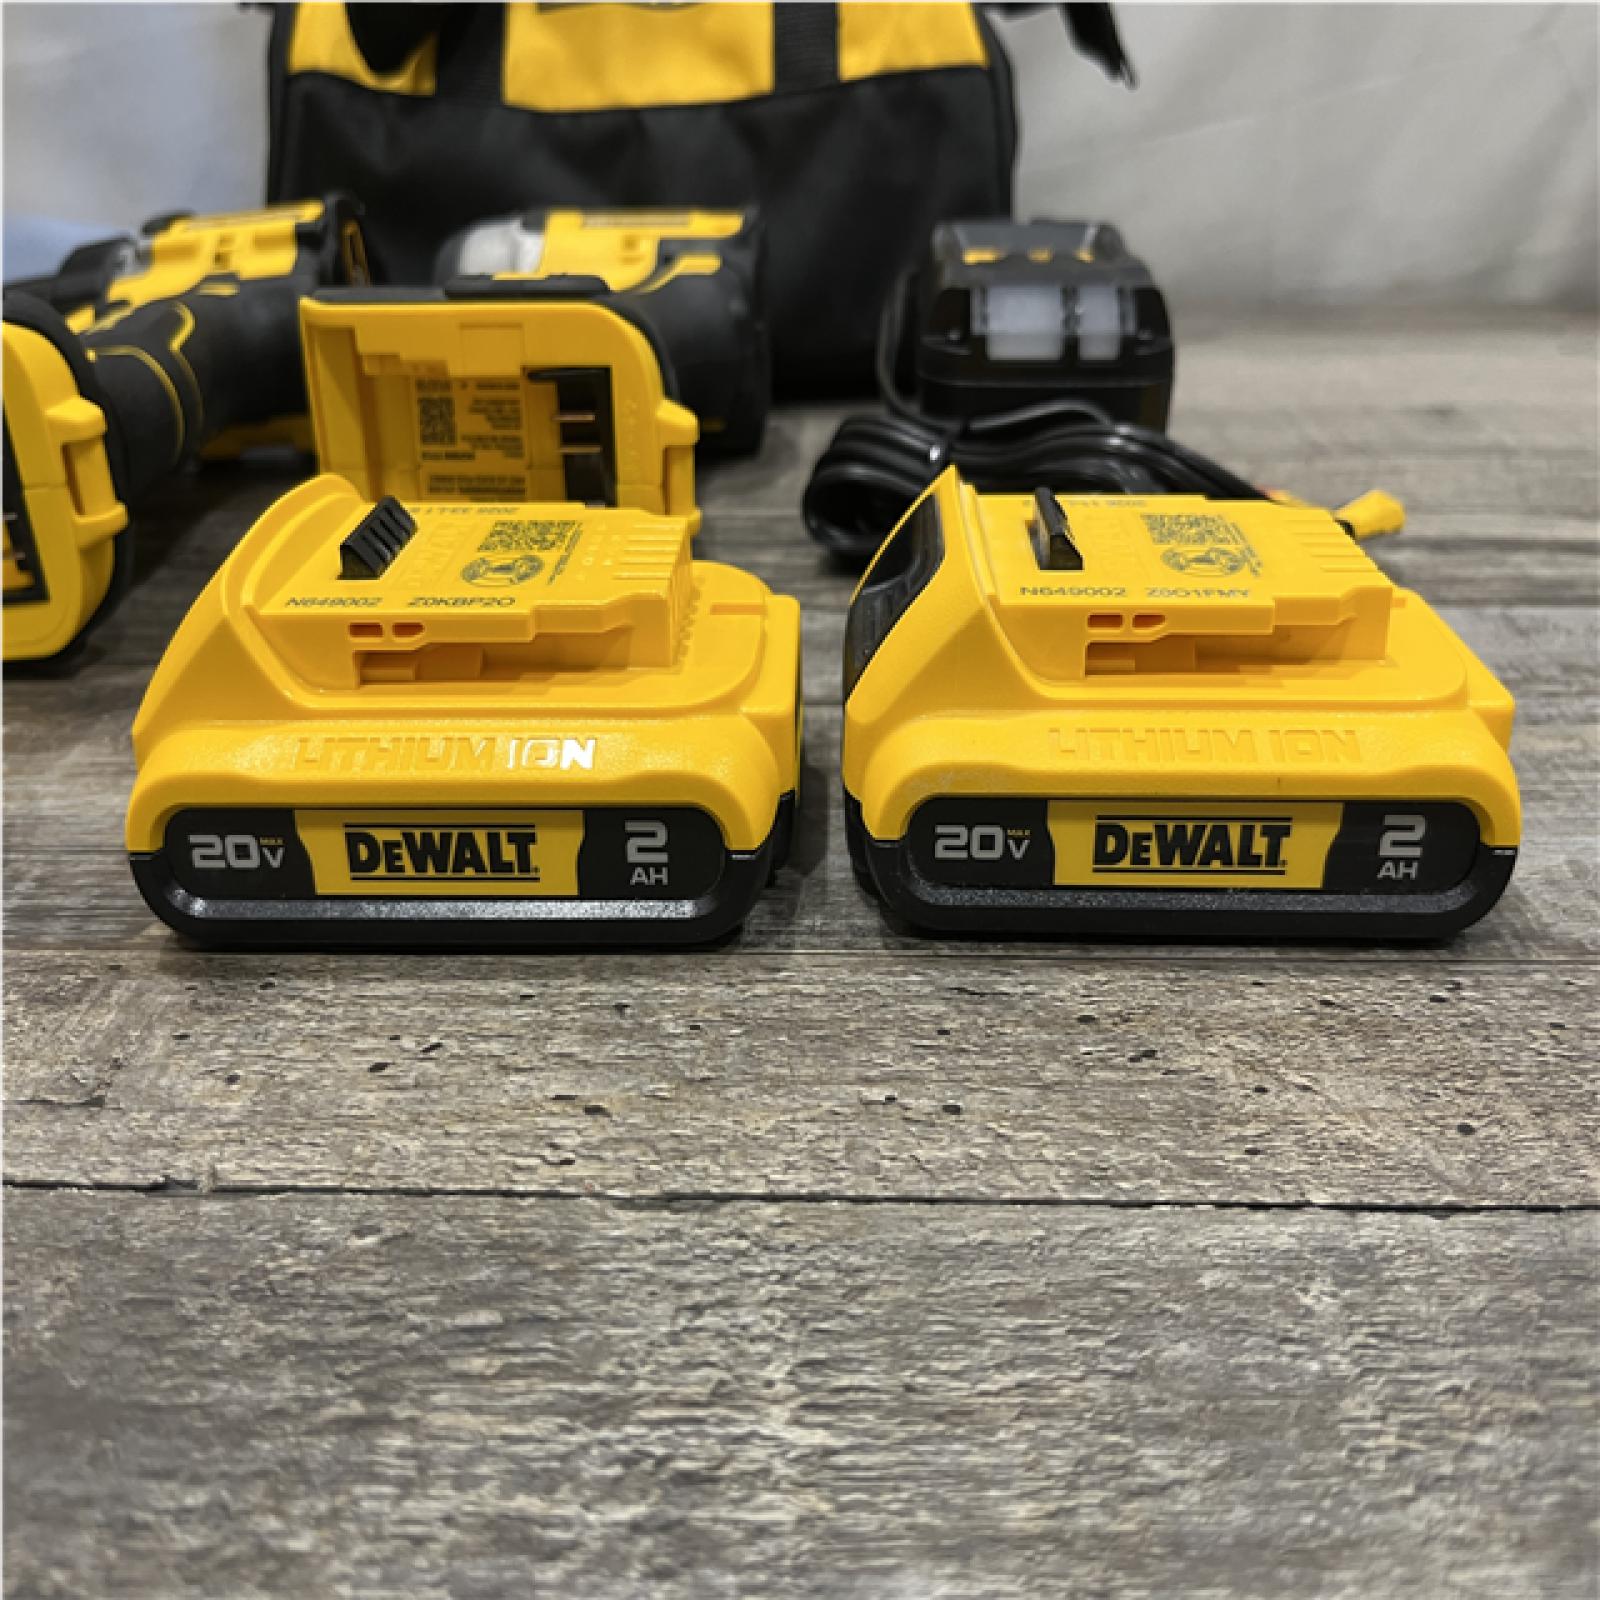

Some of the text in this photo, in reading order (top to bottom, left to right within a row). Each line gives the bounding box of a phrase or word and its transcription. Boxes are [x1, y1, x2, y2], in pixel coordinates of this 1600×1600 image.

[290, 736, 597, 770] LITHIUM ION
[1047, 729, 1363, 763] LITHIUM ION
[344, 831, 540, 873] DEWALT
[625, 819, 669, 864] 2
[1093, 823, 1293, 866] DEWALT
[1379, 814, 1426, 857] 2
[630, 866, 669, 886] AH
[1376, 859, 1419, 880] AH
